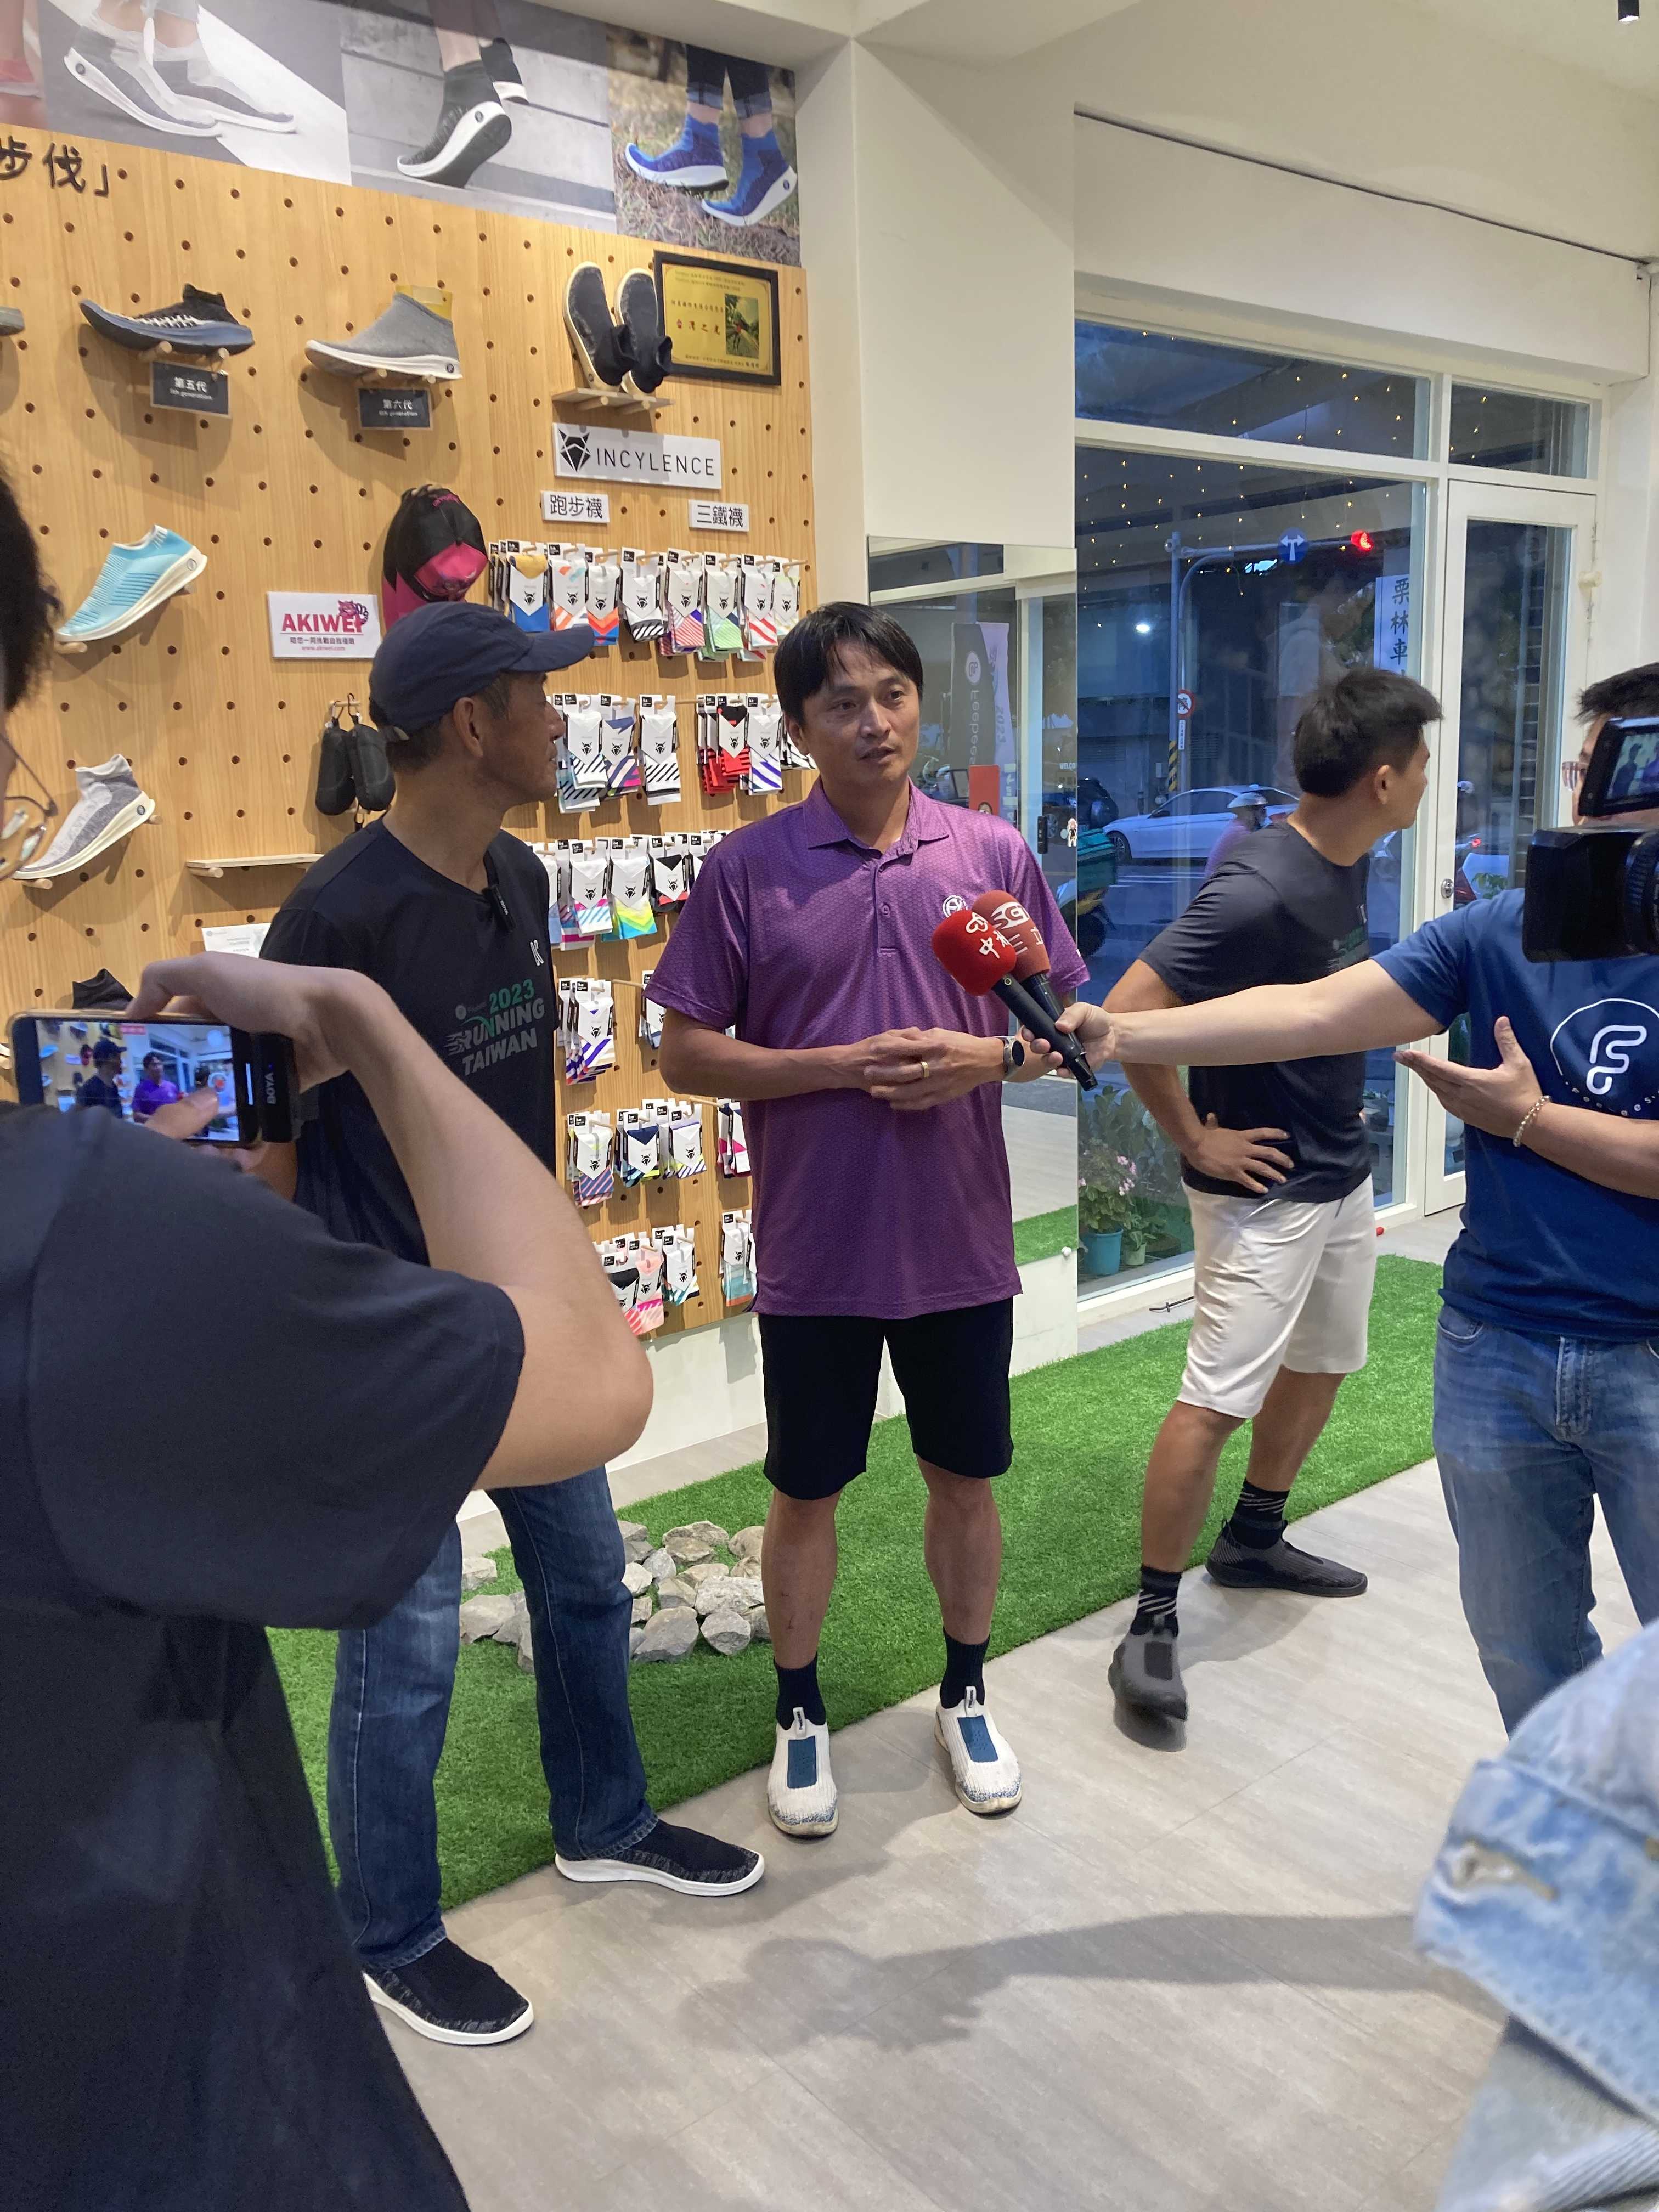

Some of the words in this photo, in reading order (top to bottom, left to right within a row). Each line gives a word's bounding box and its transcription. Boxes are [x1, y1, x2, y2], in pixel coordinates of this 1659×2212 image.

[174, 376, 207, 393] 第五代
[383, 399, 413, 410] 第六代
[596, 448, 715, 476] INCYLENCE
[550, 494, 603, 518] 跑步襪
[697, 504, 743, 527] 三鐵襪
[281, 613, 362, 633] AKIWEI
[1390, 578, 1409, 677] 栗林車
[489, 979, 535, 1014] 2023
[445, 998, 545, 1054] RUNNING
[462, 1028, 538, 1076] TAIWAN
[264, 1072, 277, 1104] BOYA
